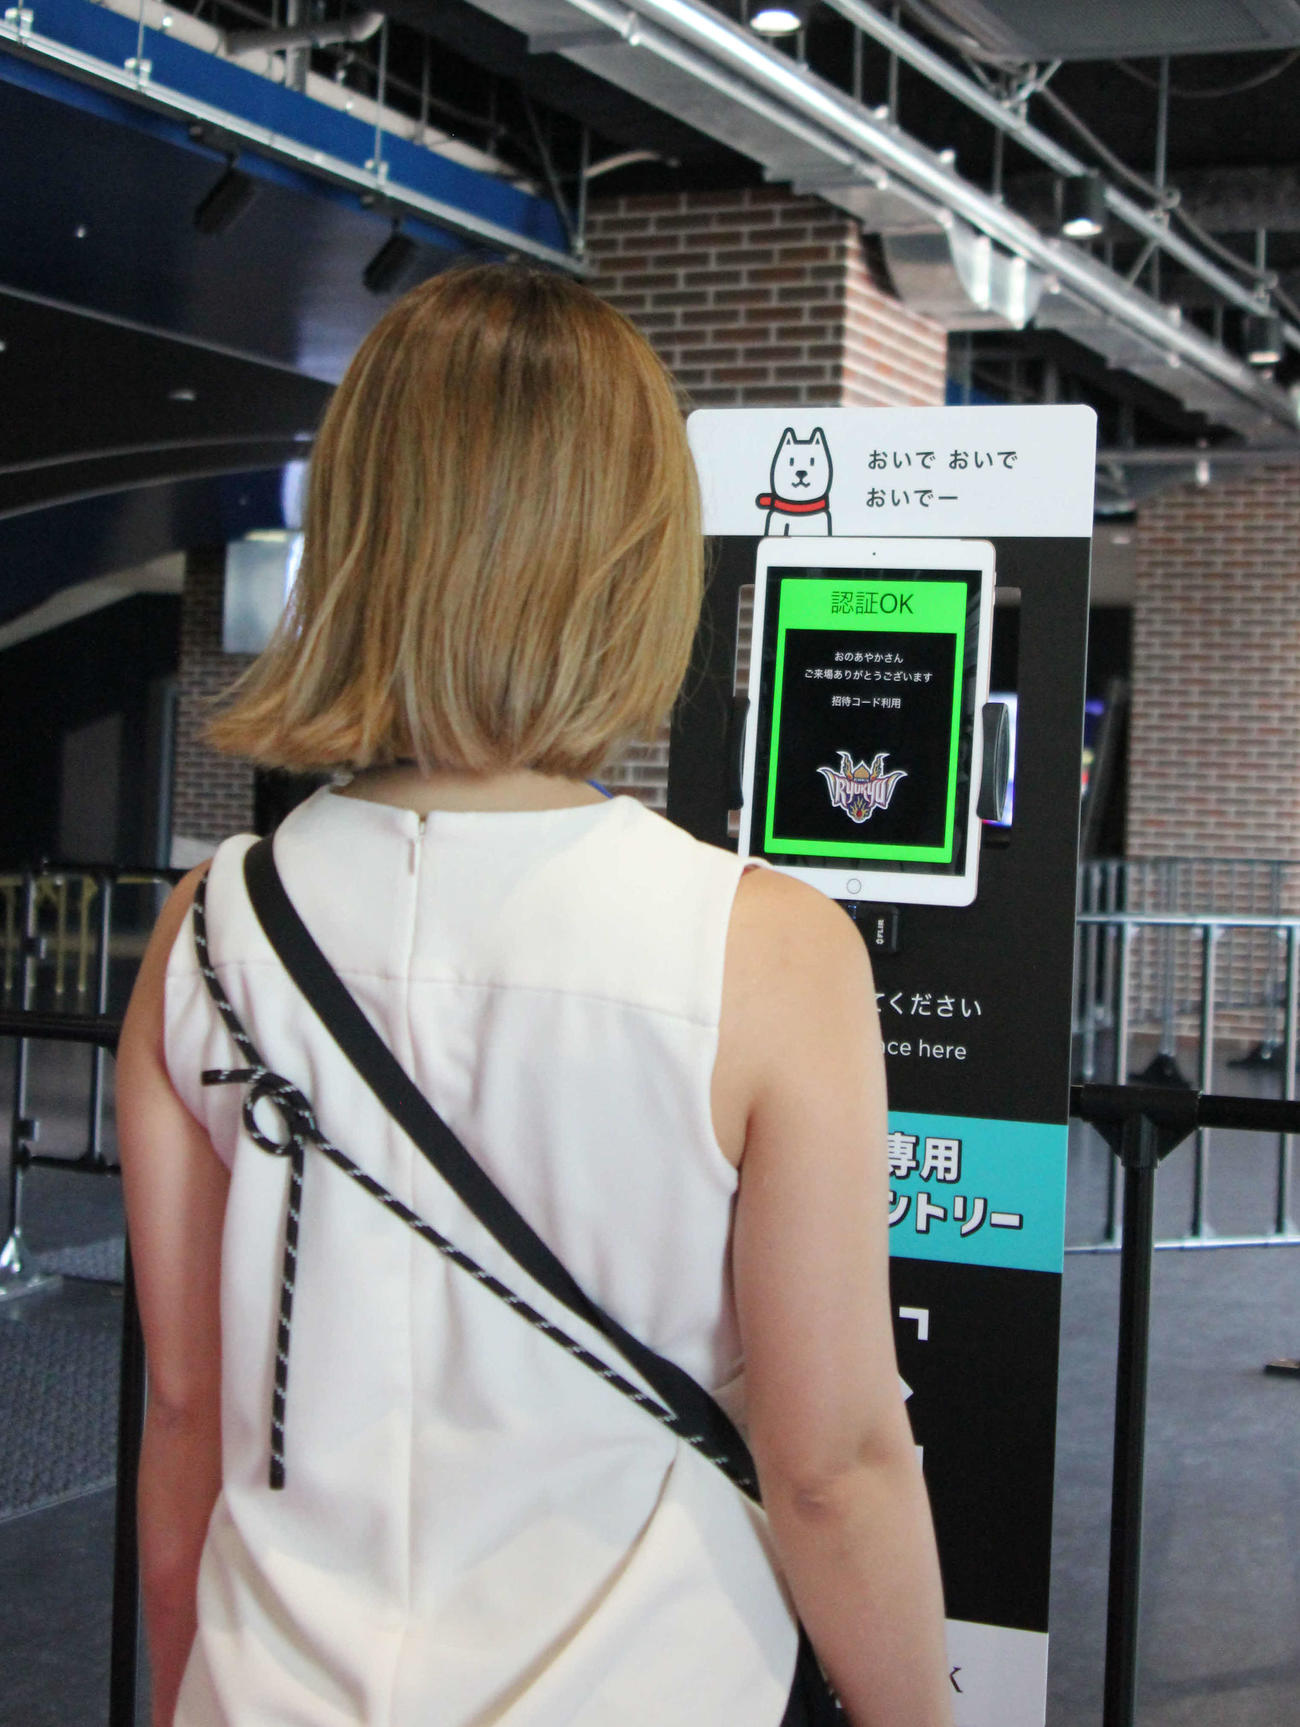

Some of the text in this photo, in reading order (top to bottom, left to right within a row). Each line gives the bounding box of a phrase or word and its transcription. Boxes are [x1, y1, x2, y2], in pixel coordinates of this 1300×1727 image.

[868, 450, 1018, 470] おいで おいで
[866, 488, 959, 508] おいでー
[831, 591, 914, 615] 認証OK
[834, 652, 904, 664] おのあやかさん
[804, 669, 933, 682] ご来場ありがとうございます
[831, 696, 902, 709] 招待コード利用
[880, 1039, 967, 1060] ce here
